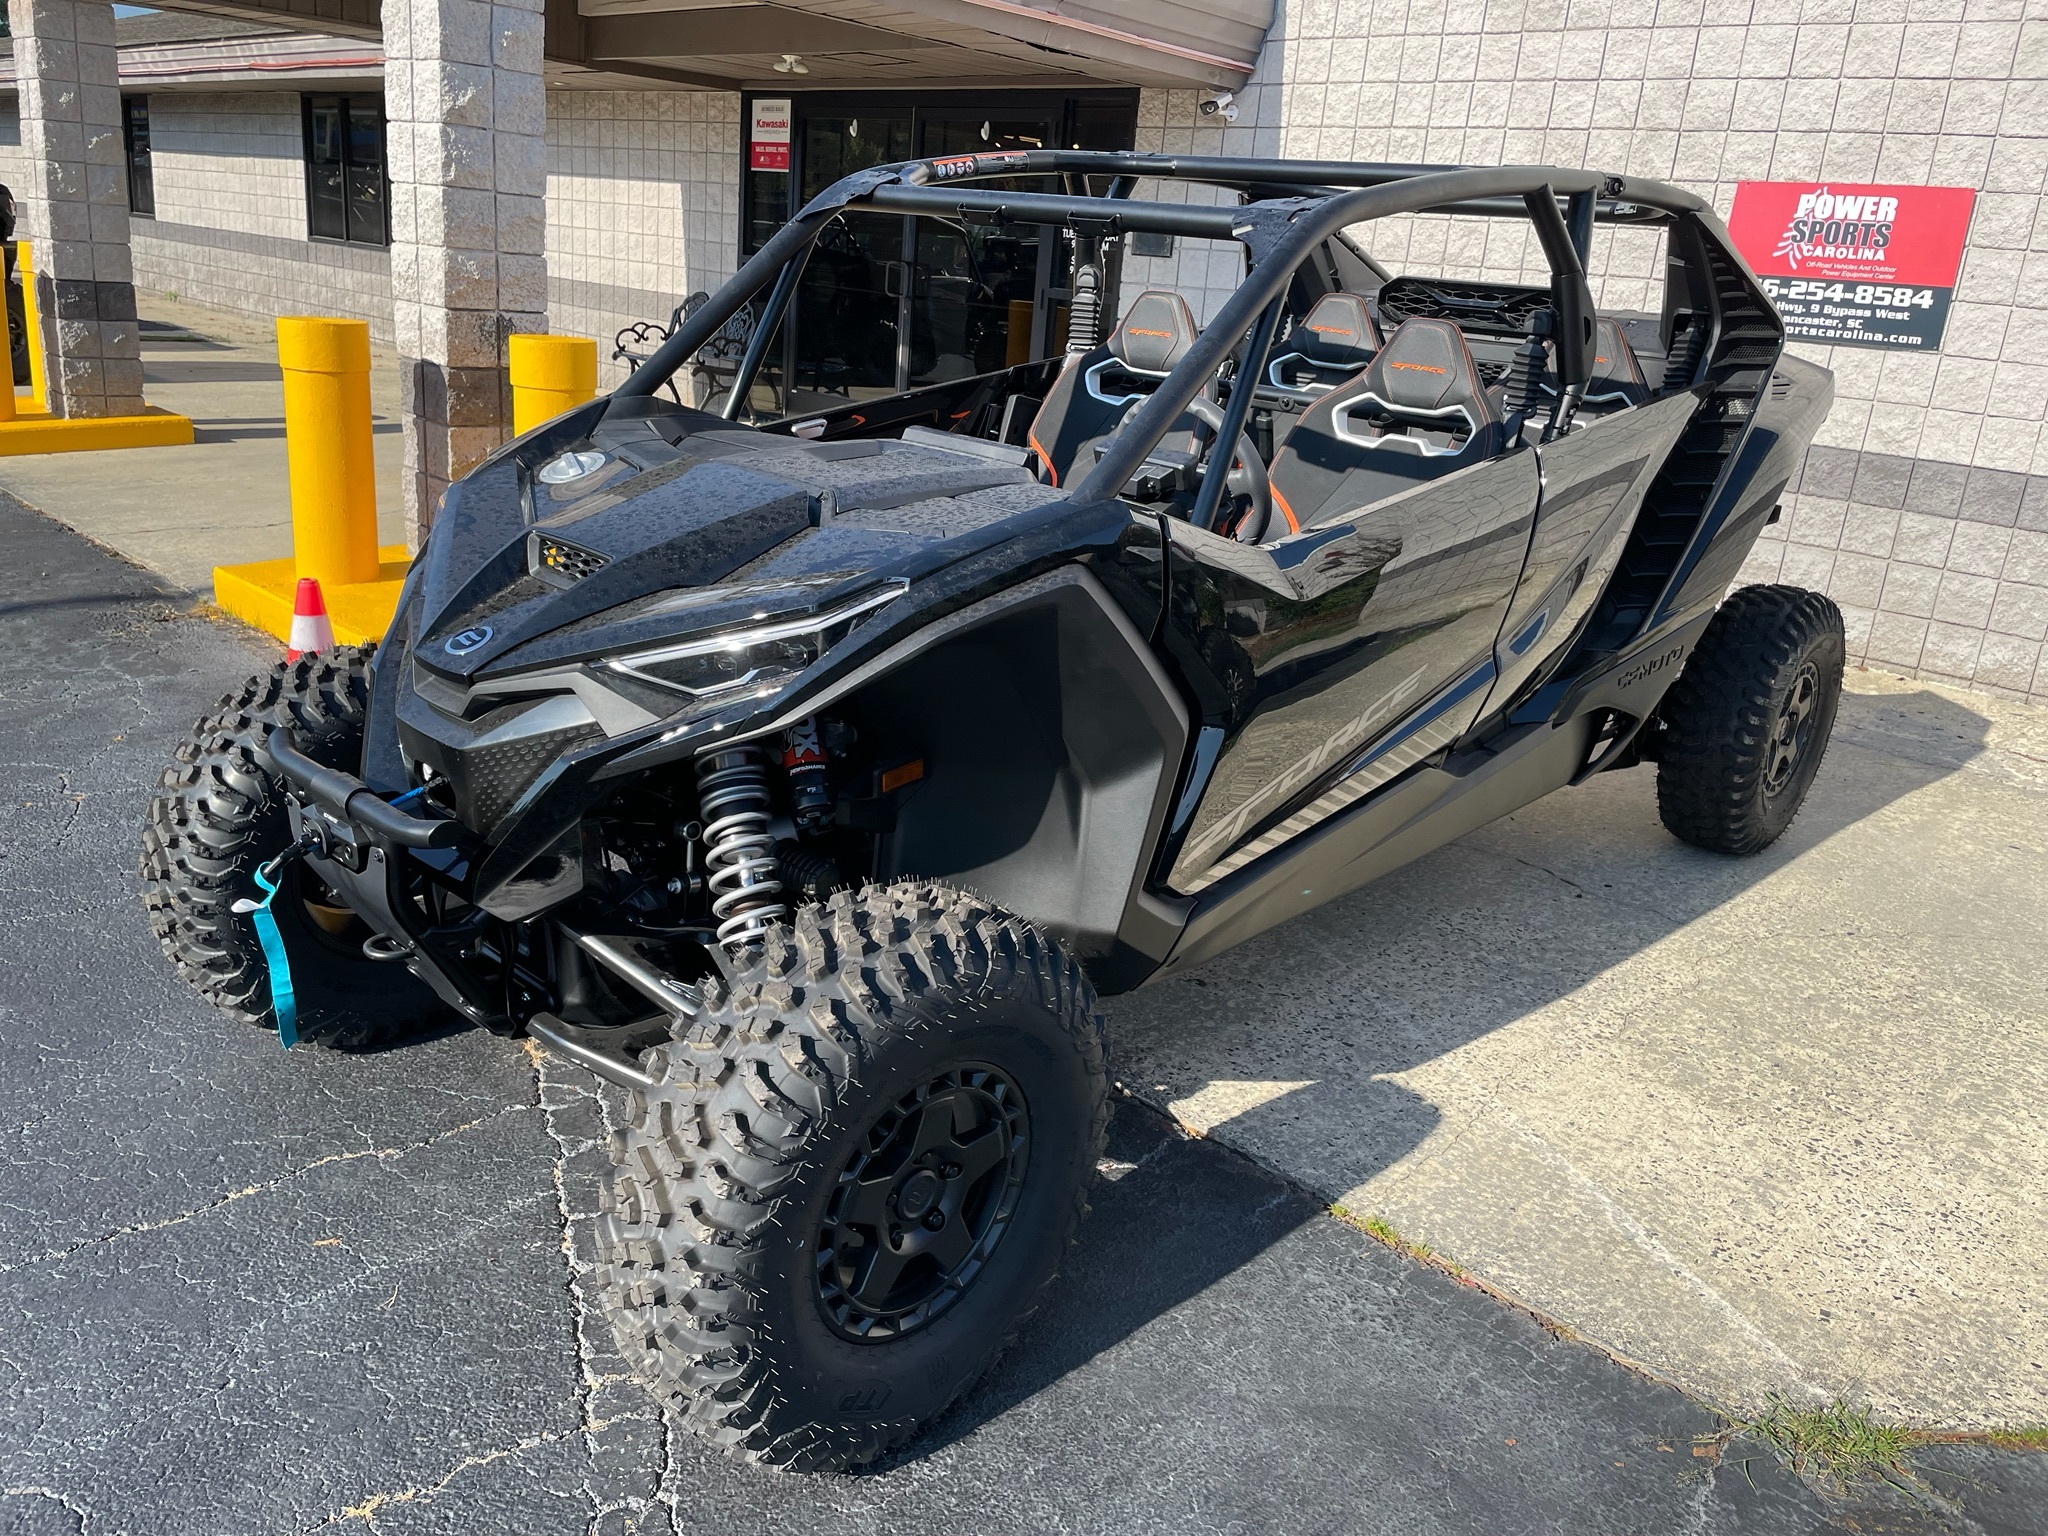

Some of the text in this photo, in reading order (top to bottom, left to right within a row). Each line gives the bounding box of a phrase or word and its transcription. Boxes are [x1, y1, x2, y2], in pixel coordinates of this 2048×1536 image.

[756, 119, 789, 128] Kawasaki
[1794, 194, 1899, 221] POWER
[1790, 218, 1893, 249] SPORTS
[1802, 245, 1885, 261] CAROLINA
[1805, 261, 1833, 269] Off-Road
[1821, 269, 1841, 277] Power
[1841, 270, 1874, 279] Equipment
[1759, 278, 1934, 309] 6-254-8584
[1775, 301, 1911, 320] Hwy. 9 Bypass West
[1783, 315, 1864, 329] ancaster, SC
[1785, 325, 1923, 345] ortscarolina.com
[1617, 644, 1685, 690] CFMOTO
[792, 715, 821, 759] OX
